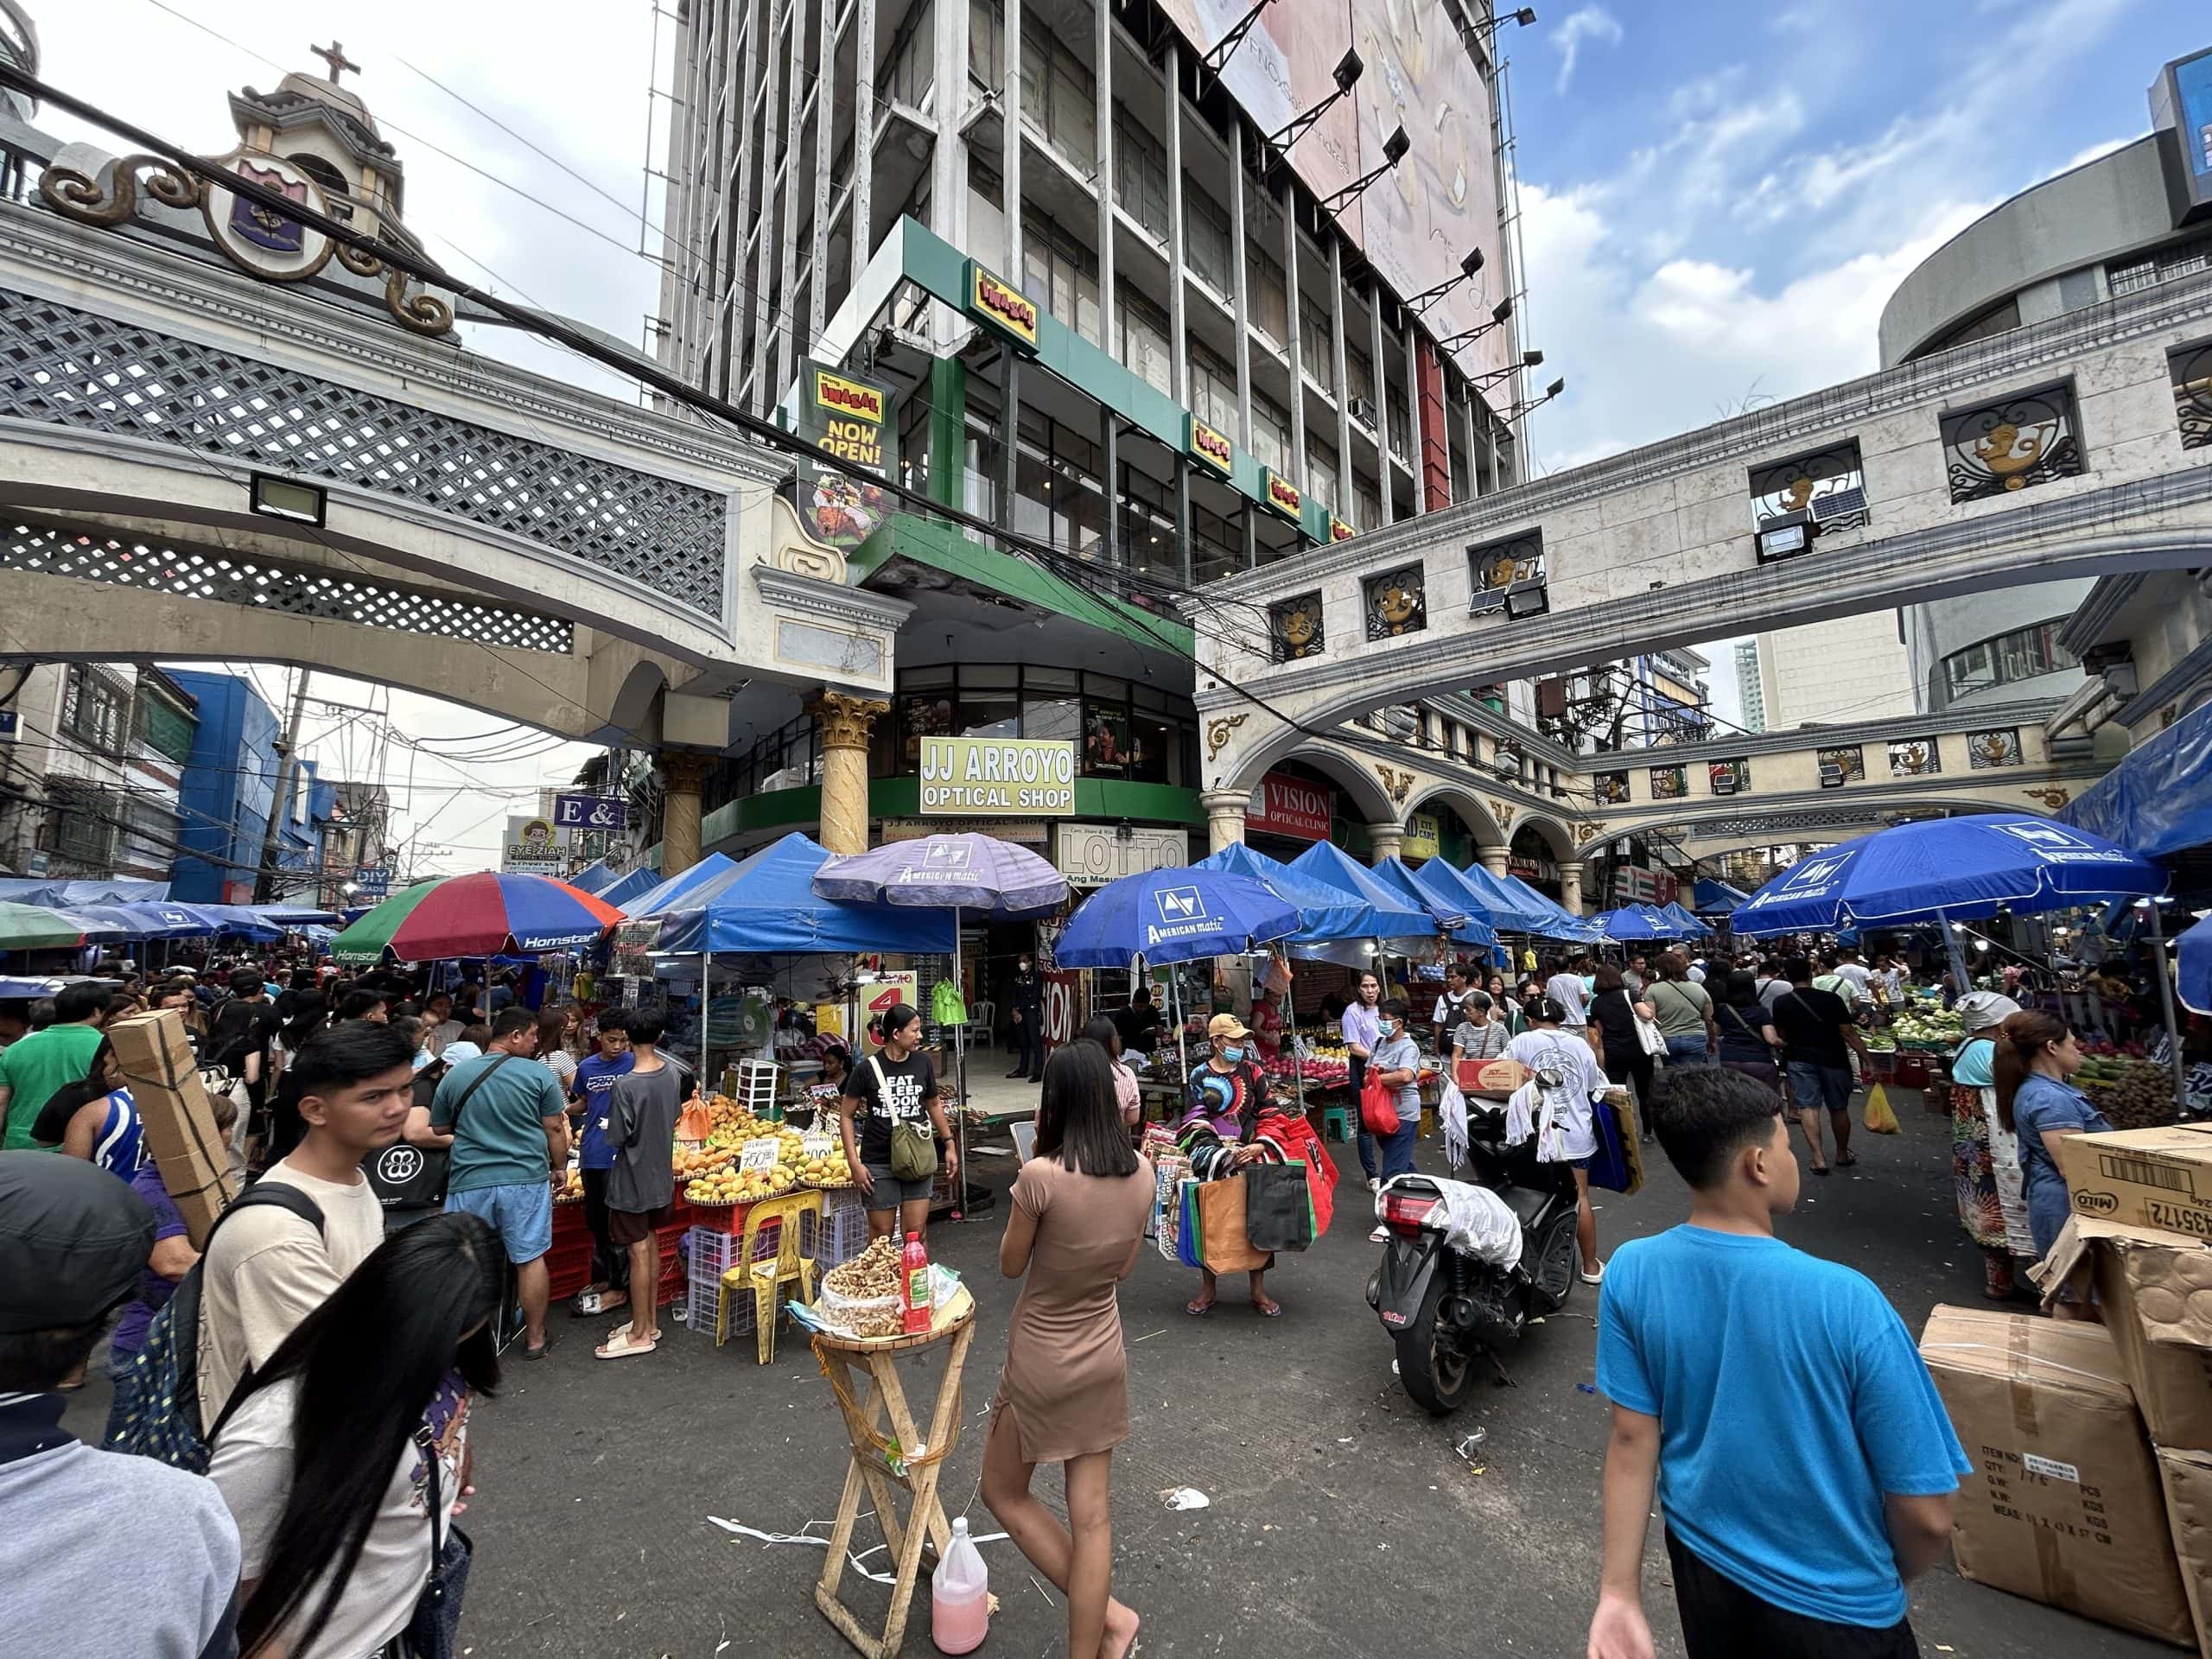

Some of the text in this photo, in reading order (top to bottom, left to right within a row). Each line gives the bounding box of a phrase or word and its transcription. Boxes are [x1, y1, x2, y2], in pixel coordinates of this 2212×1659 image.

[978, 279, 1034, 330] INASAL
[820, 382, 879, 414] INASAL
[828, 420, 877, 446] NOW
[817, 437, 881, 464] OPEN!
[923, 745, 1073, 784] JJ ARROYO
[924, 786, 1071, 808] OPTICAL SHOP
[1270, 782, 1328, 817] VISION
[562, 800, 615, 825] E &
[1270, 810, 1329, 832] OPTICAL CLINIC
[1421, 820, 1433, 830] EYE
[1418, 830, 1435, 840] CARE
[1062, 834, 1184, 874] LOTTO
[899, 867, 951, 882] AMERICAN
[1067, 875, 1087, 884] Ang
[1147, 918, 1224, 944] AMERICAN matic
[524, 934, 594, 948] Homstar
[336, 950, 381, 961] Homstar
[887, 1074, 915, 1087] EAT
[878, 1084, 923, 1098] SLEEP
[872, 1104, 922, 1118] REPEAT
[2077, 1196, 2112, 1209] MILO
[1982, 1445, 2003, 1459] ITEM
[2080, 1484, 2101, 1498] PCS
[2082, 1499, 2105, 1514] KGS
[2086, 1515, 2108, 1529] KGS
[2094, 1531, 2112, 1545] CM
